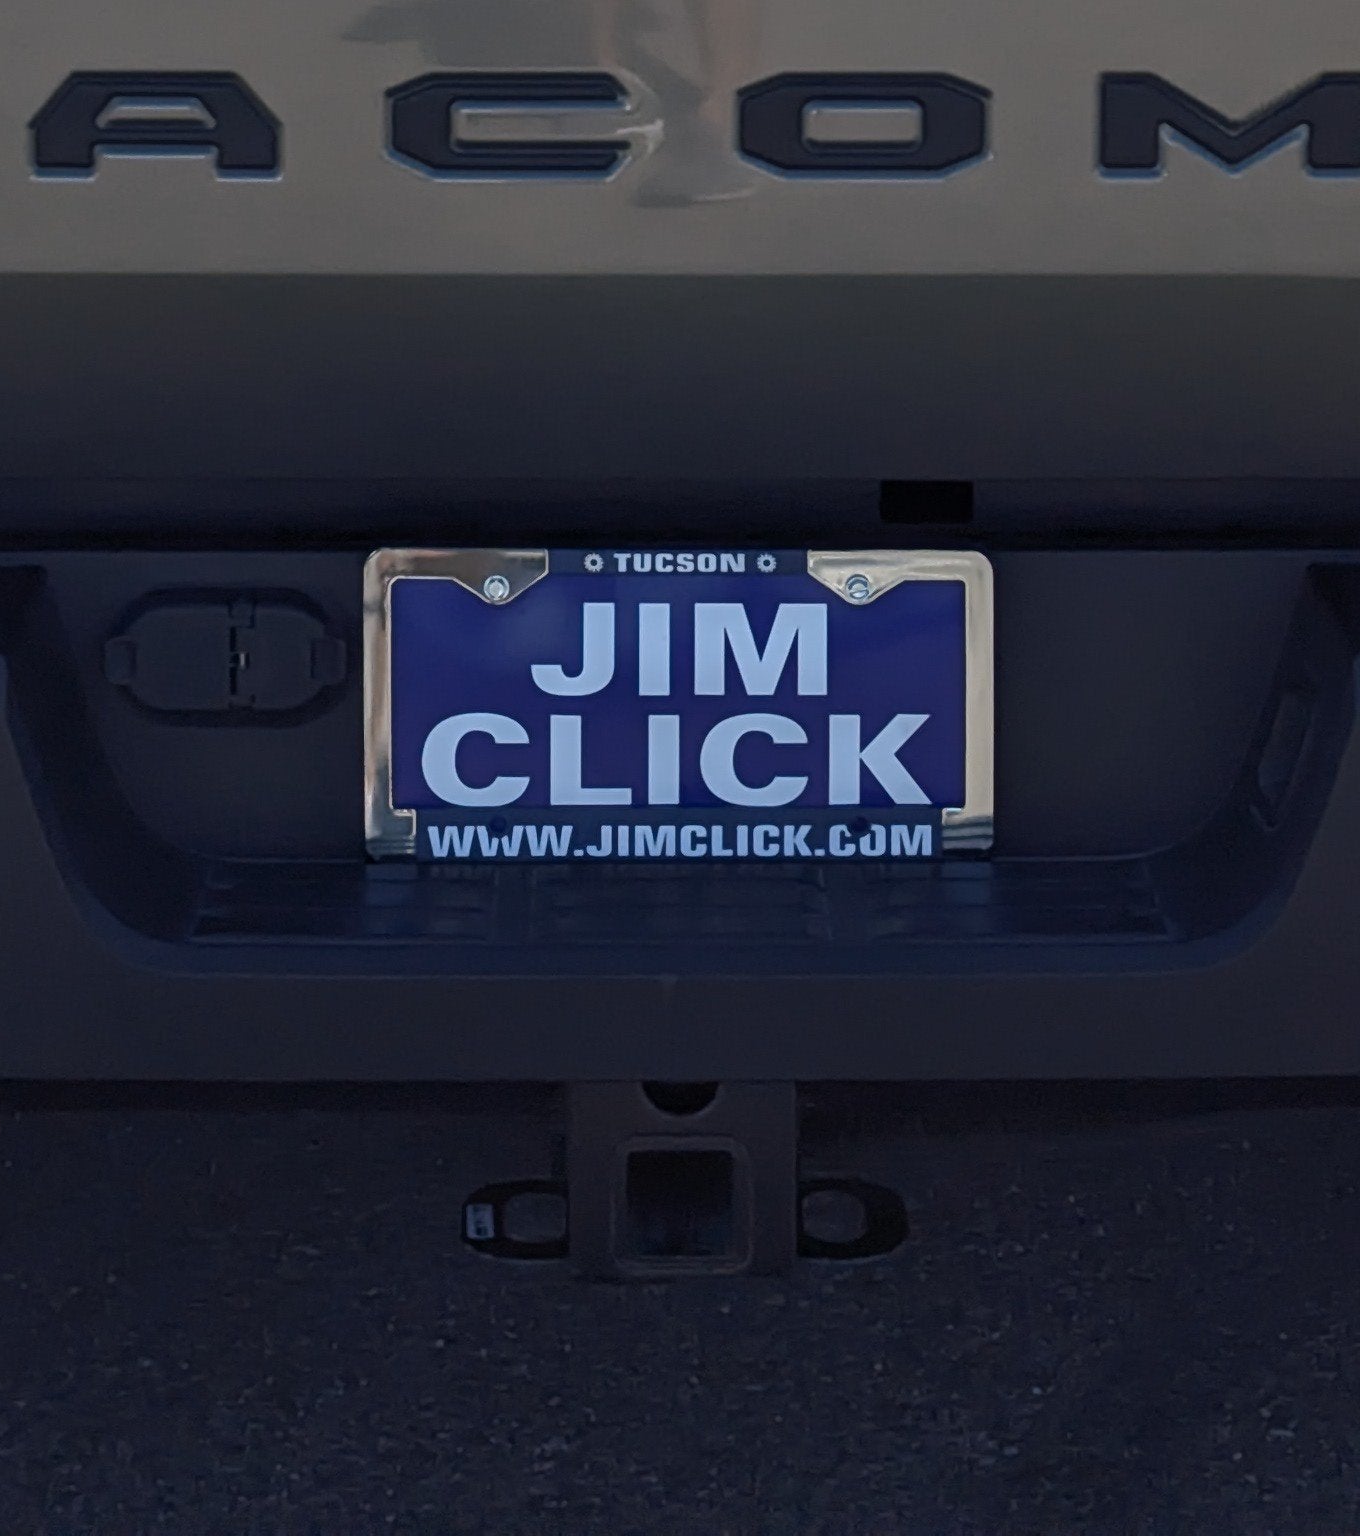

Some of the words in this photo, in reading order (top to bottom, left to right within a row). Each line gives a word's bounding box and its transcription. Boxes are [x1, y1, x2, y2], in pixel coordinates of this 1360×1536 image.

[613, 553, 746, 573] TUCSON
[530, 601, 828, 696] JIM
[420, 712, 933, 807] CLICK
[427, 823, 933, 857] WWW.JIMCLICK.COM
